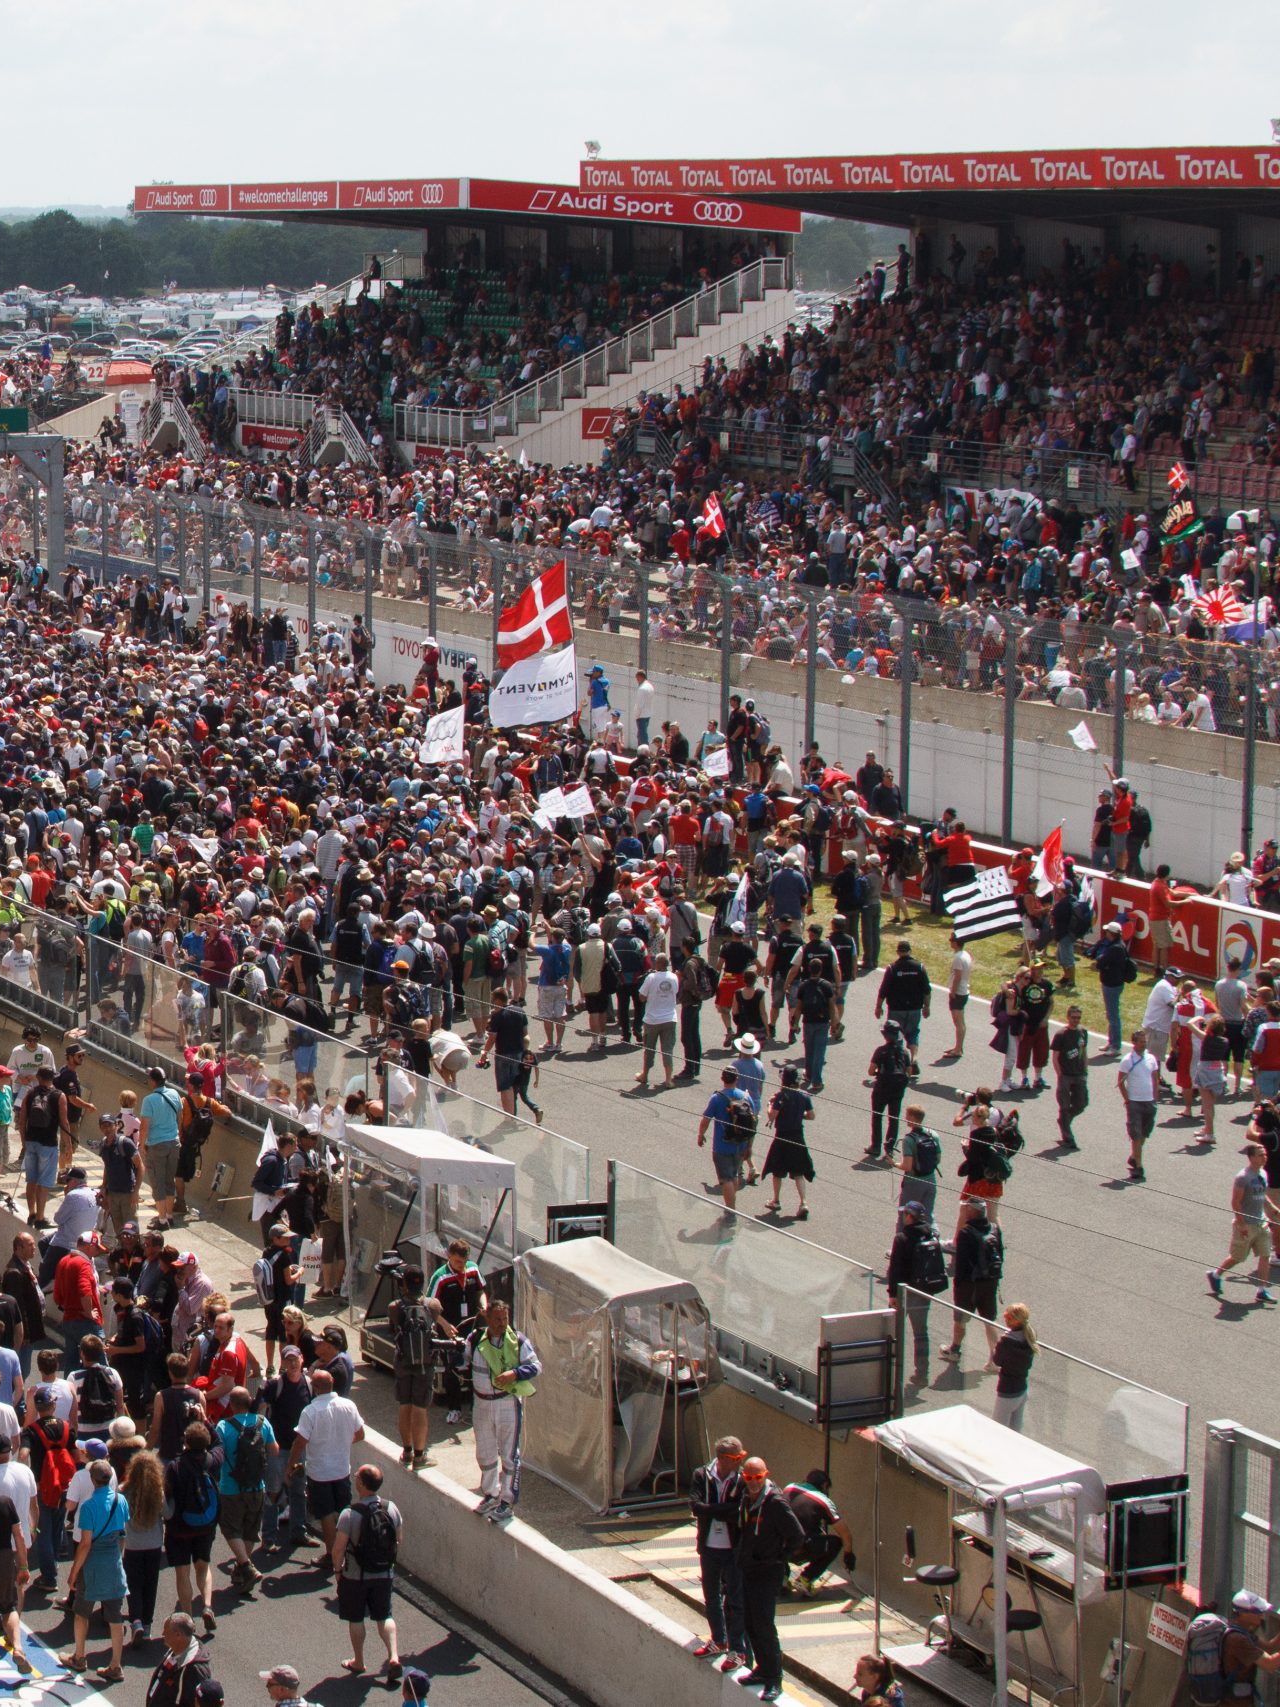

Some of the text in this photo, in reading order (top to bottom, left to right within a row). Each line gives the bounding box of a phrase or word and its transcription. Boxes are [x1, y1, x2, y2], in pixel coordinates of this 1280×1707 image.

[584, 166, 624, 187] TOTAL
[630, 166, 672, 187] TOTAL
[679, 166, 724, 187] TOTAL
[728, 165, 776, 186] TOTAL
[783, 164, 833, 185] TOTAL
[840, 162, 893, 184] TOTAL
[900, 161, 954, 183] TOTAL
[963, 160, 1021, 182] TOTAL
[1030, 158, 1092, 181] TOTAL
[1101, 156, 1164, 180] TOTAL
[1175, 155, 1243, 180] TOTAL
[155, 191, 193, 207] Audi Sport
[238, 188, 328, 205] #welcomechallenges
[365, 187, 414, 204] Audi Sport
[557, 191, 674, 217] Audi Sport
[1111, 896, 1210, 958] TOAL
[1154, 1606, 1187, 1632] INTERDICTION
